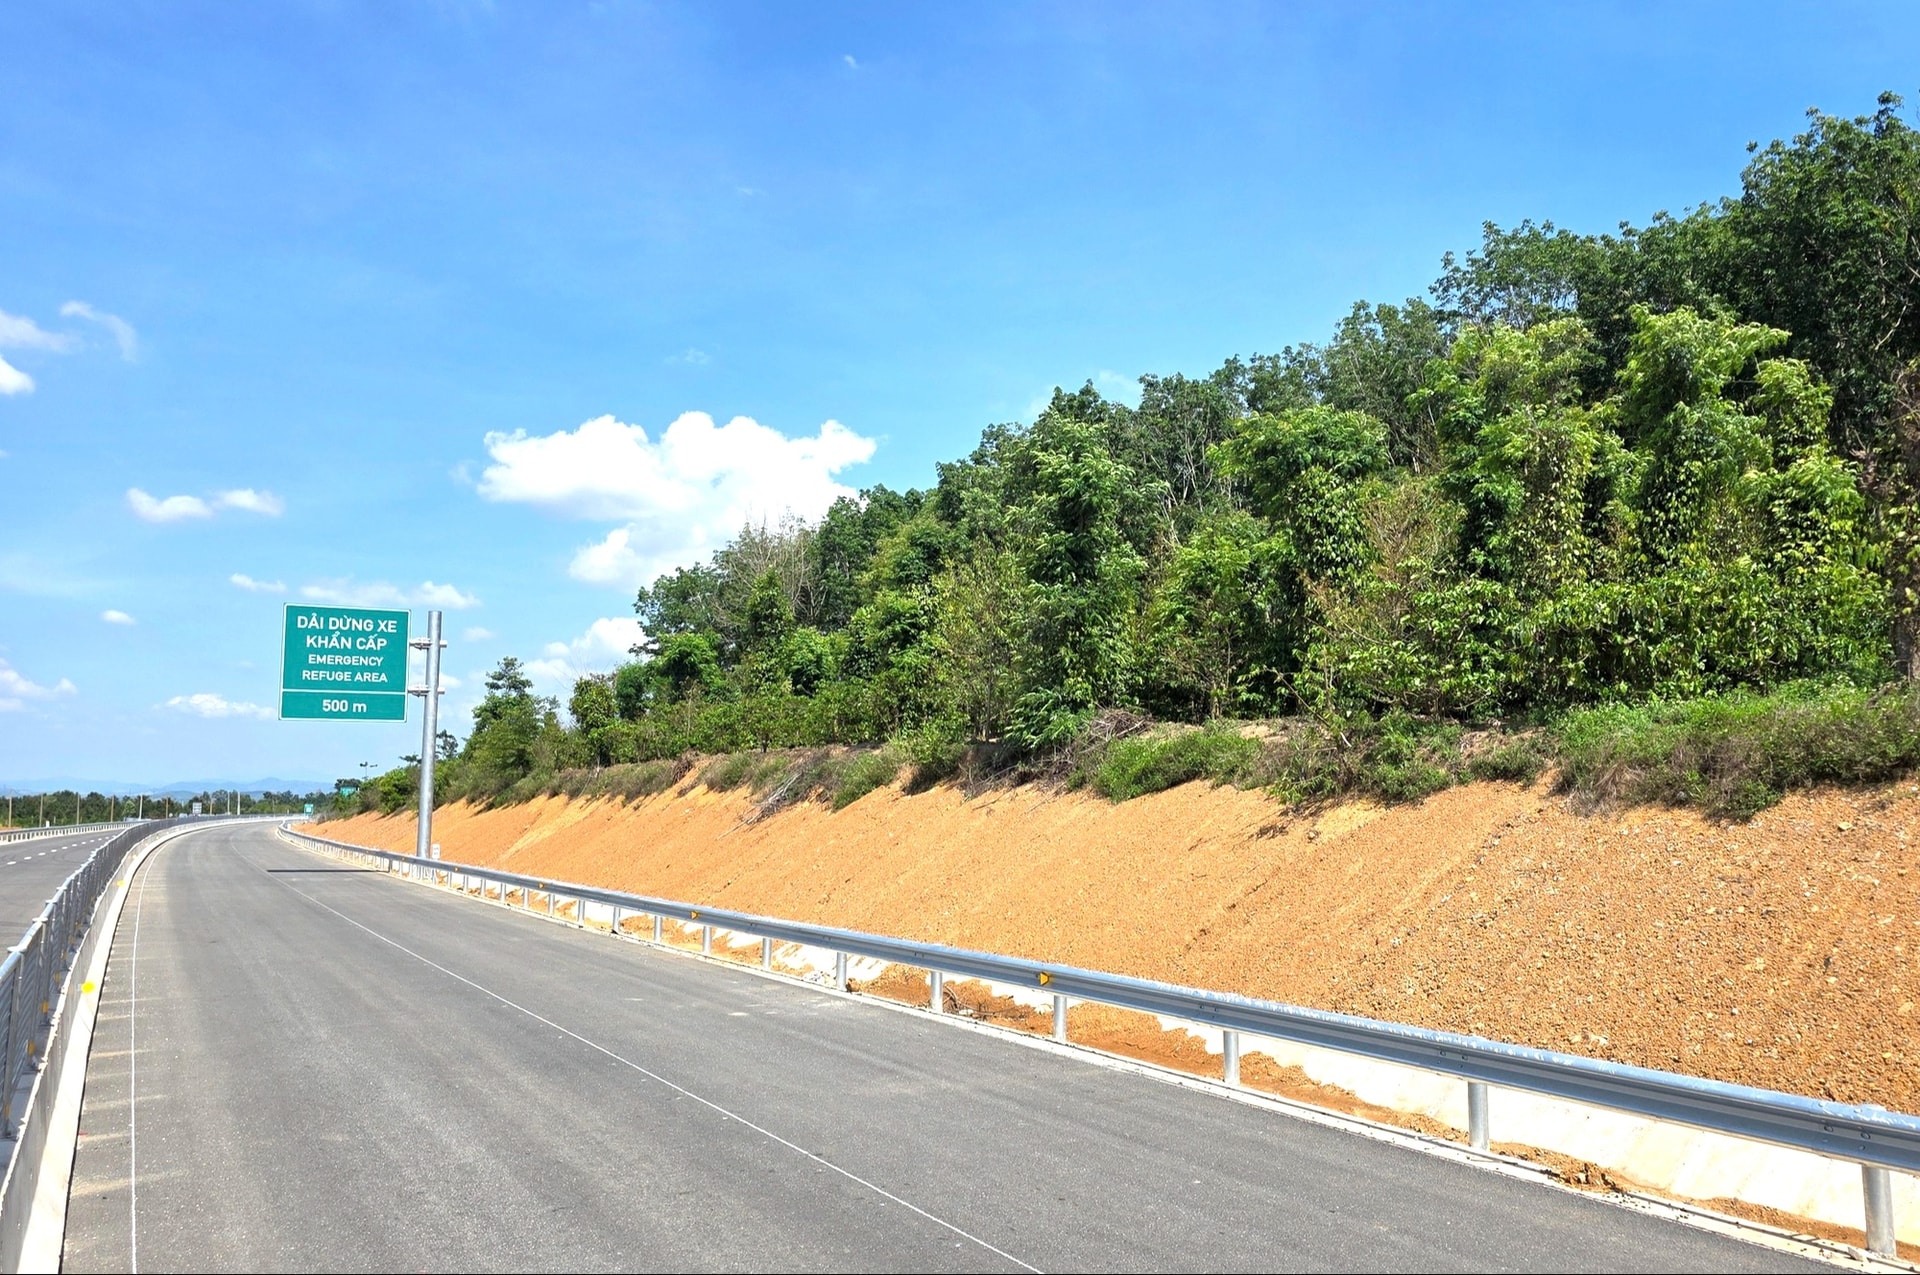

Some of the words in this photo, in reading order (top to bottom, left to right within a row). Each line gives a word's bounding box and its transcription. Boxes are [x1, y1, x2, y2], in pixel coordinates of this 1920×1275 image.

[297, 612, 324, 629] DẢI
[329, 615, 374, 632] DỪNG
[377, 620, 397, 633] XE
[306, 631, 352, 649] KHẨN
[356, 634, 387, 650] CẤP
[308, 654, 384, 666] EMERGENCY
[302, 670, 352, 681] REFUGE
[354, 672, 388, 683] AREA
[322, 699, 348, 712] 500
[352, 704, 367, 713] m
